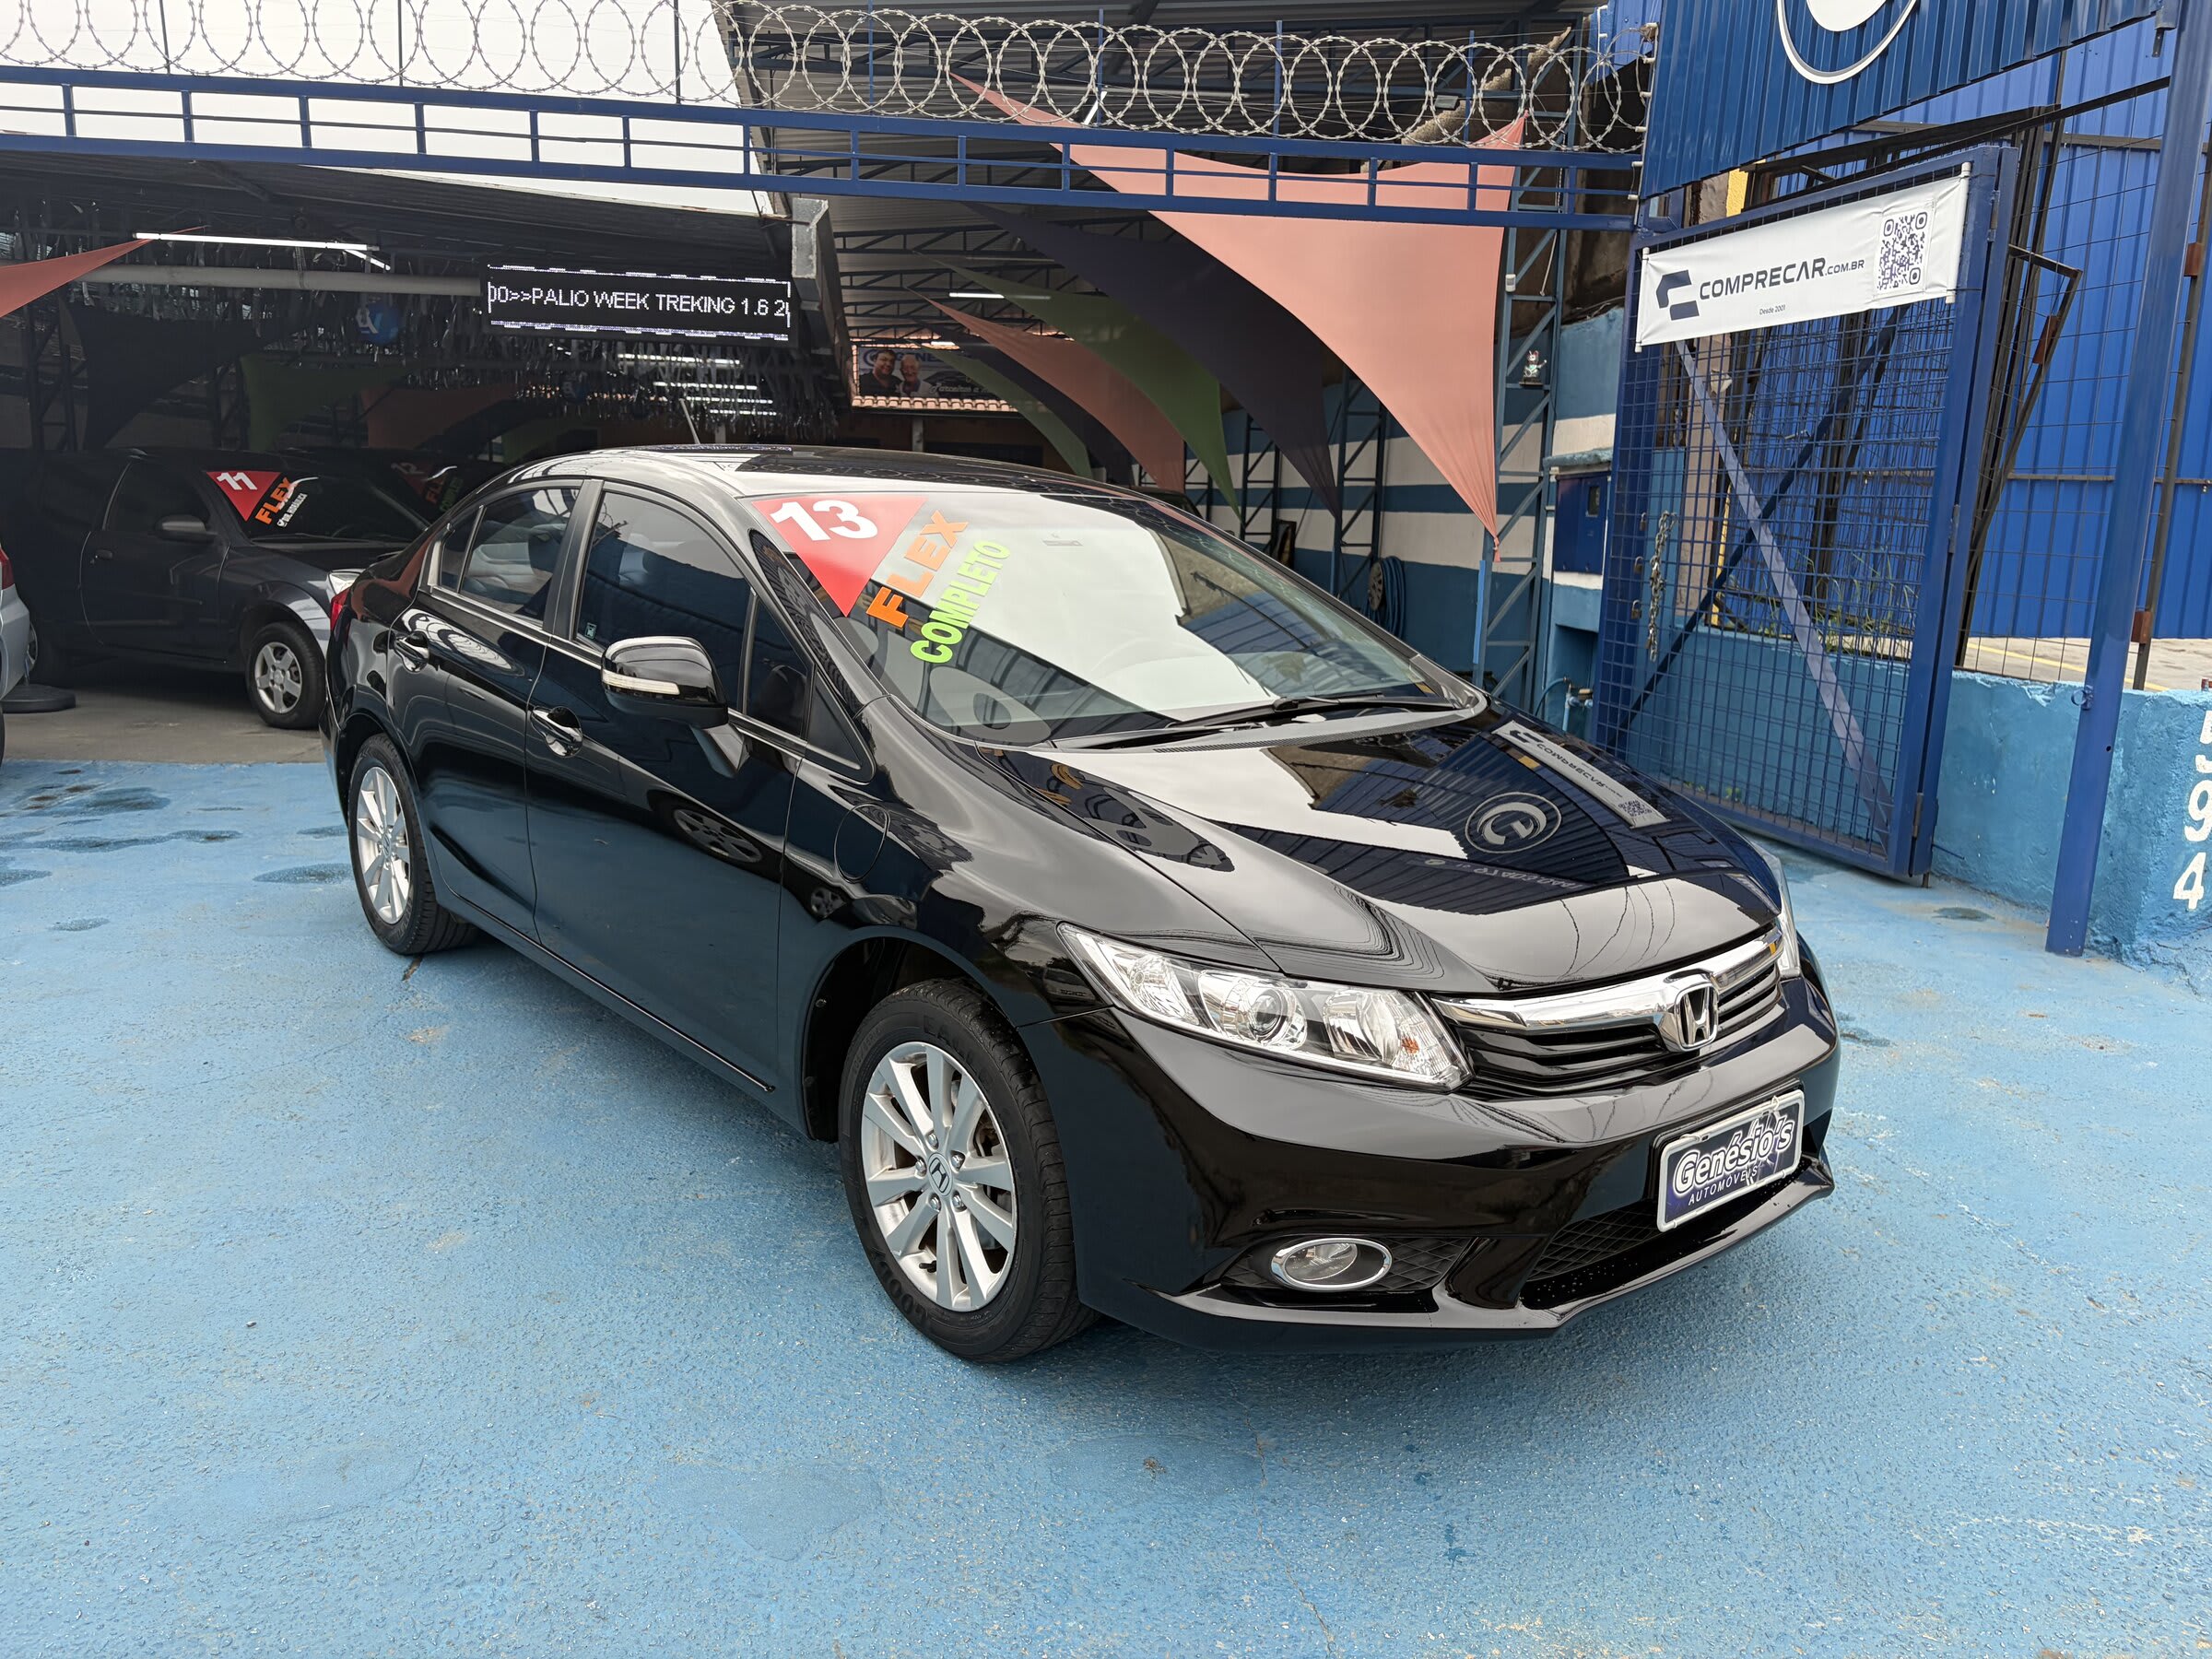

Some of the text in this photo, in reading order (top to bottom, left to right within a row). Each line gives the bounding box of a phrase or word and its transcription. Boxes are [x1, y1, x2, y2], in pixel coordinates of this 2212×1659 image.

[593, 290, 650, 310] WEEK
[654, 293, 735, 314] TREKING
[740, 297, 770, 316] 1.6
[1759, 303, 1786, 316] Desde 2001
[216, 471, 258, 491] 11
[254, 477, 300, 524] FLEX
[769, 499, 878, 542] 13
[865, 510, 969, 629] FLEX
[909, 539, 1011, 665] COMPLETO
[1673, 1114, 1794, 1196] Genésio's
